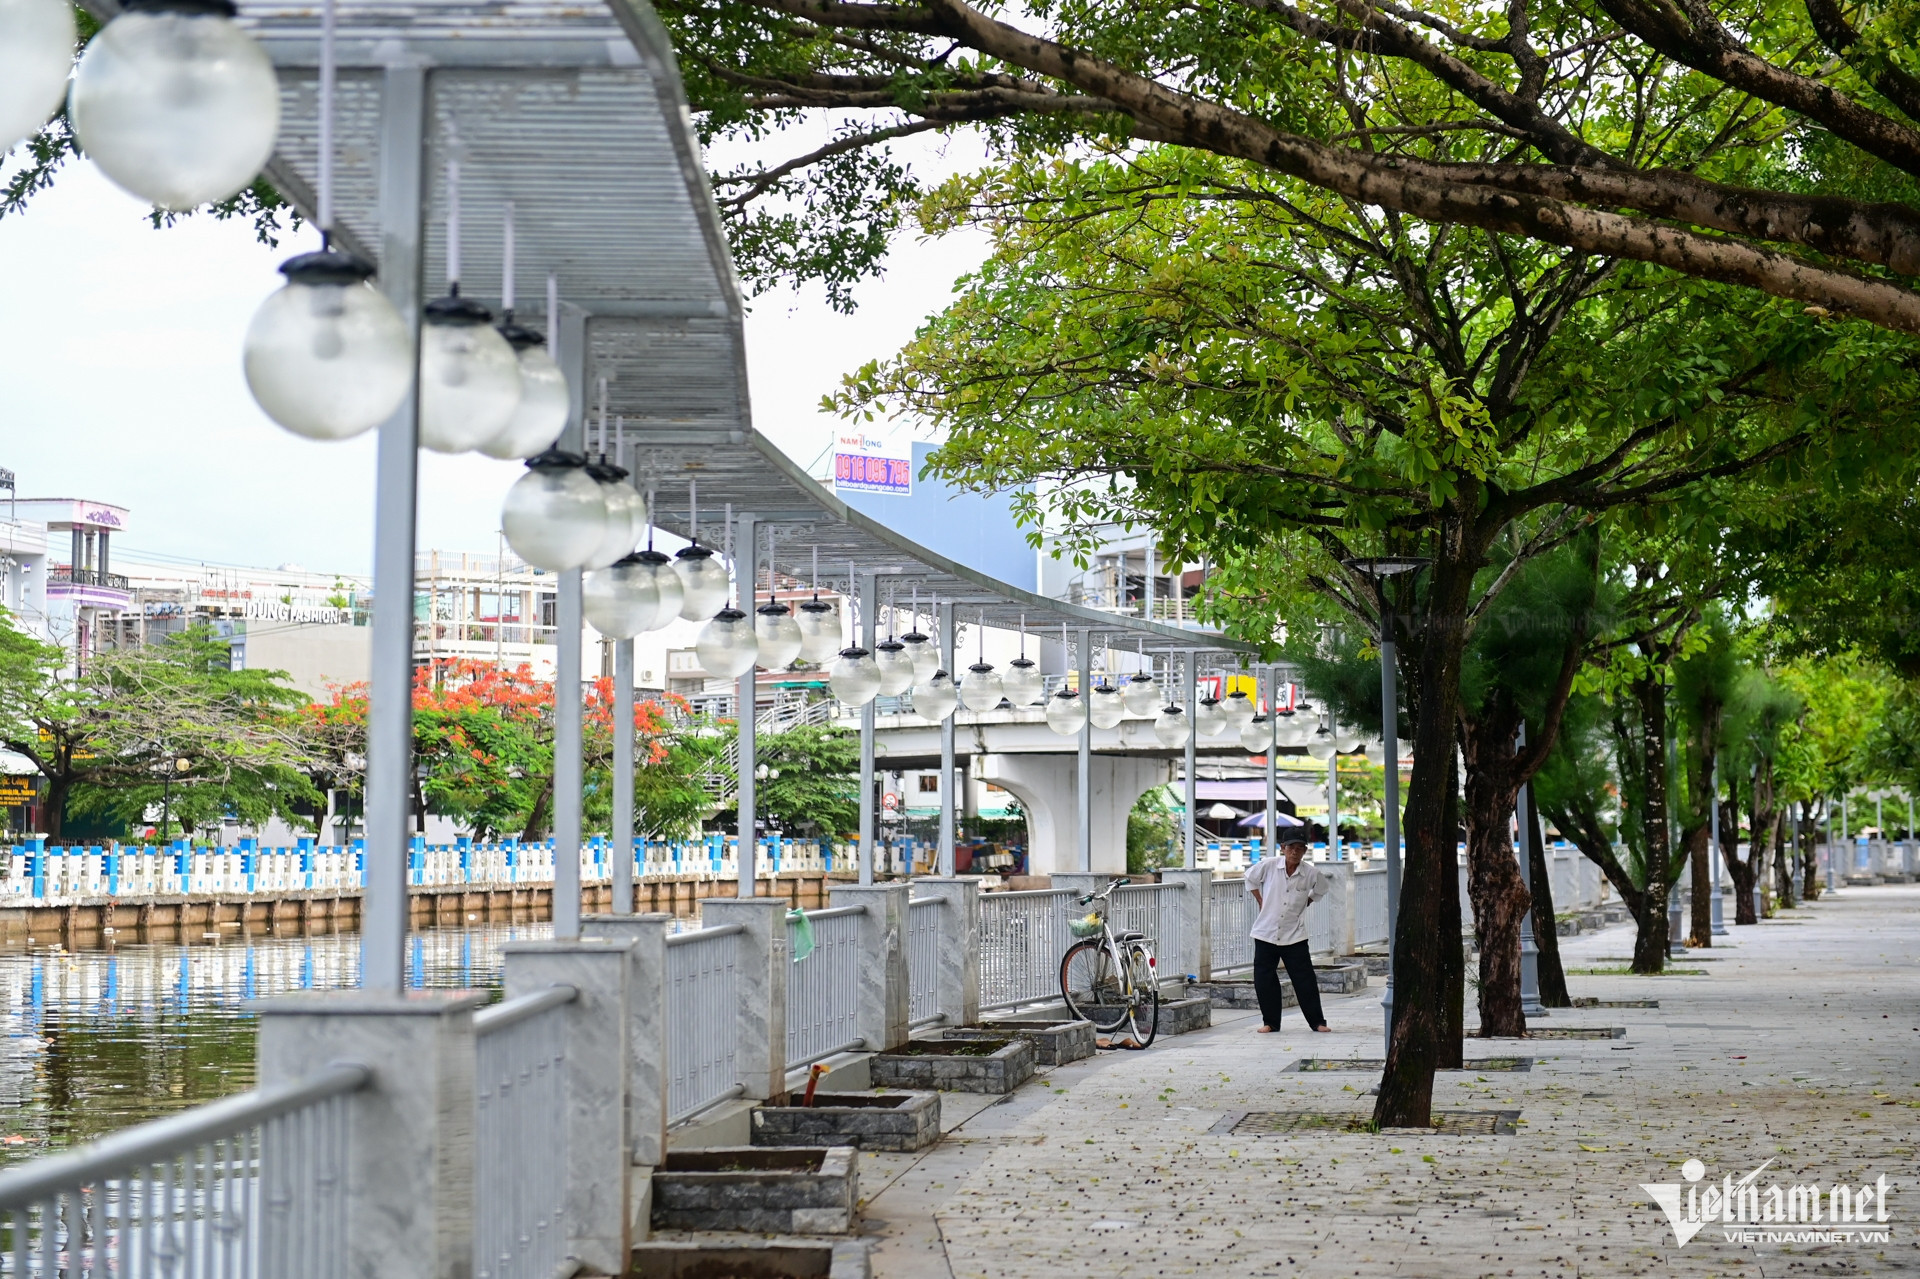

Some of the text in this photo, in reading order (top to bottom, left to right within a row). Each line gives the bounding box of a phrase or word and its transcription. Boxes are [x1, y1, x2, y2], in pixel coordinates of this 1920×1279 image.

[840, 436, 858, 446] NAM
[836, 454, 909, 486] 0916 095 795
[837, 480, 909, 493] billboardquangcao.com
[290, 606, 338, 624] FASHION
